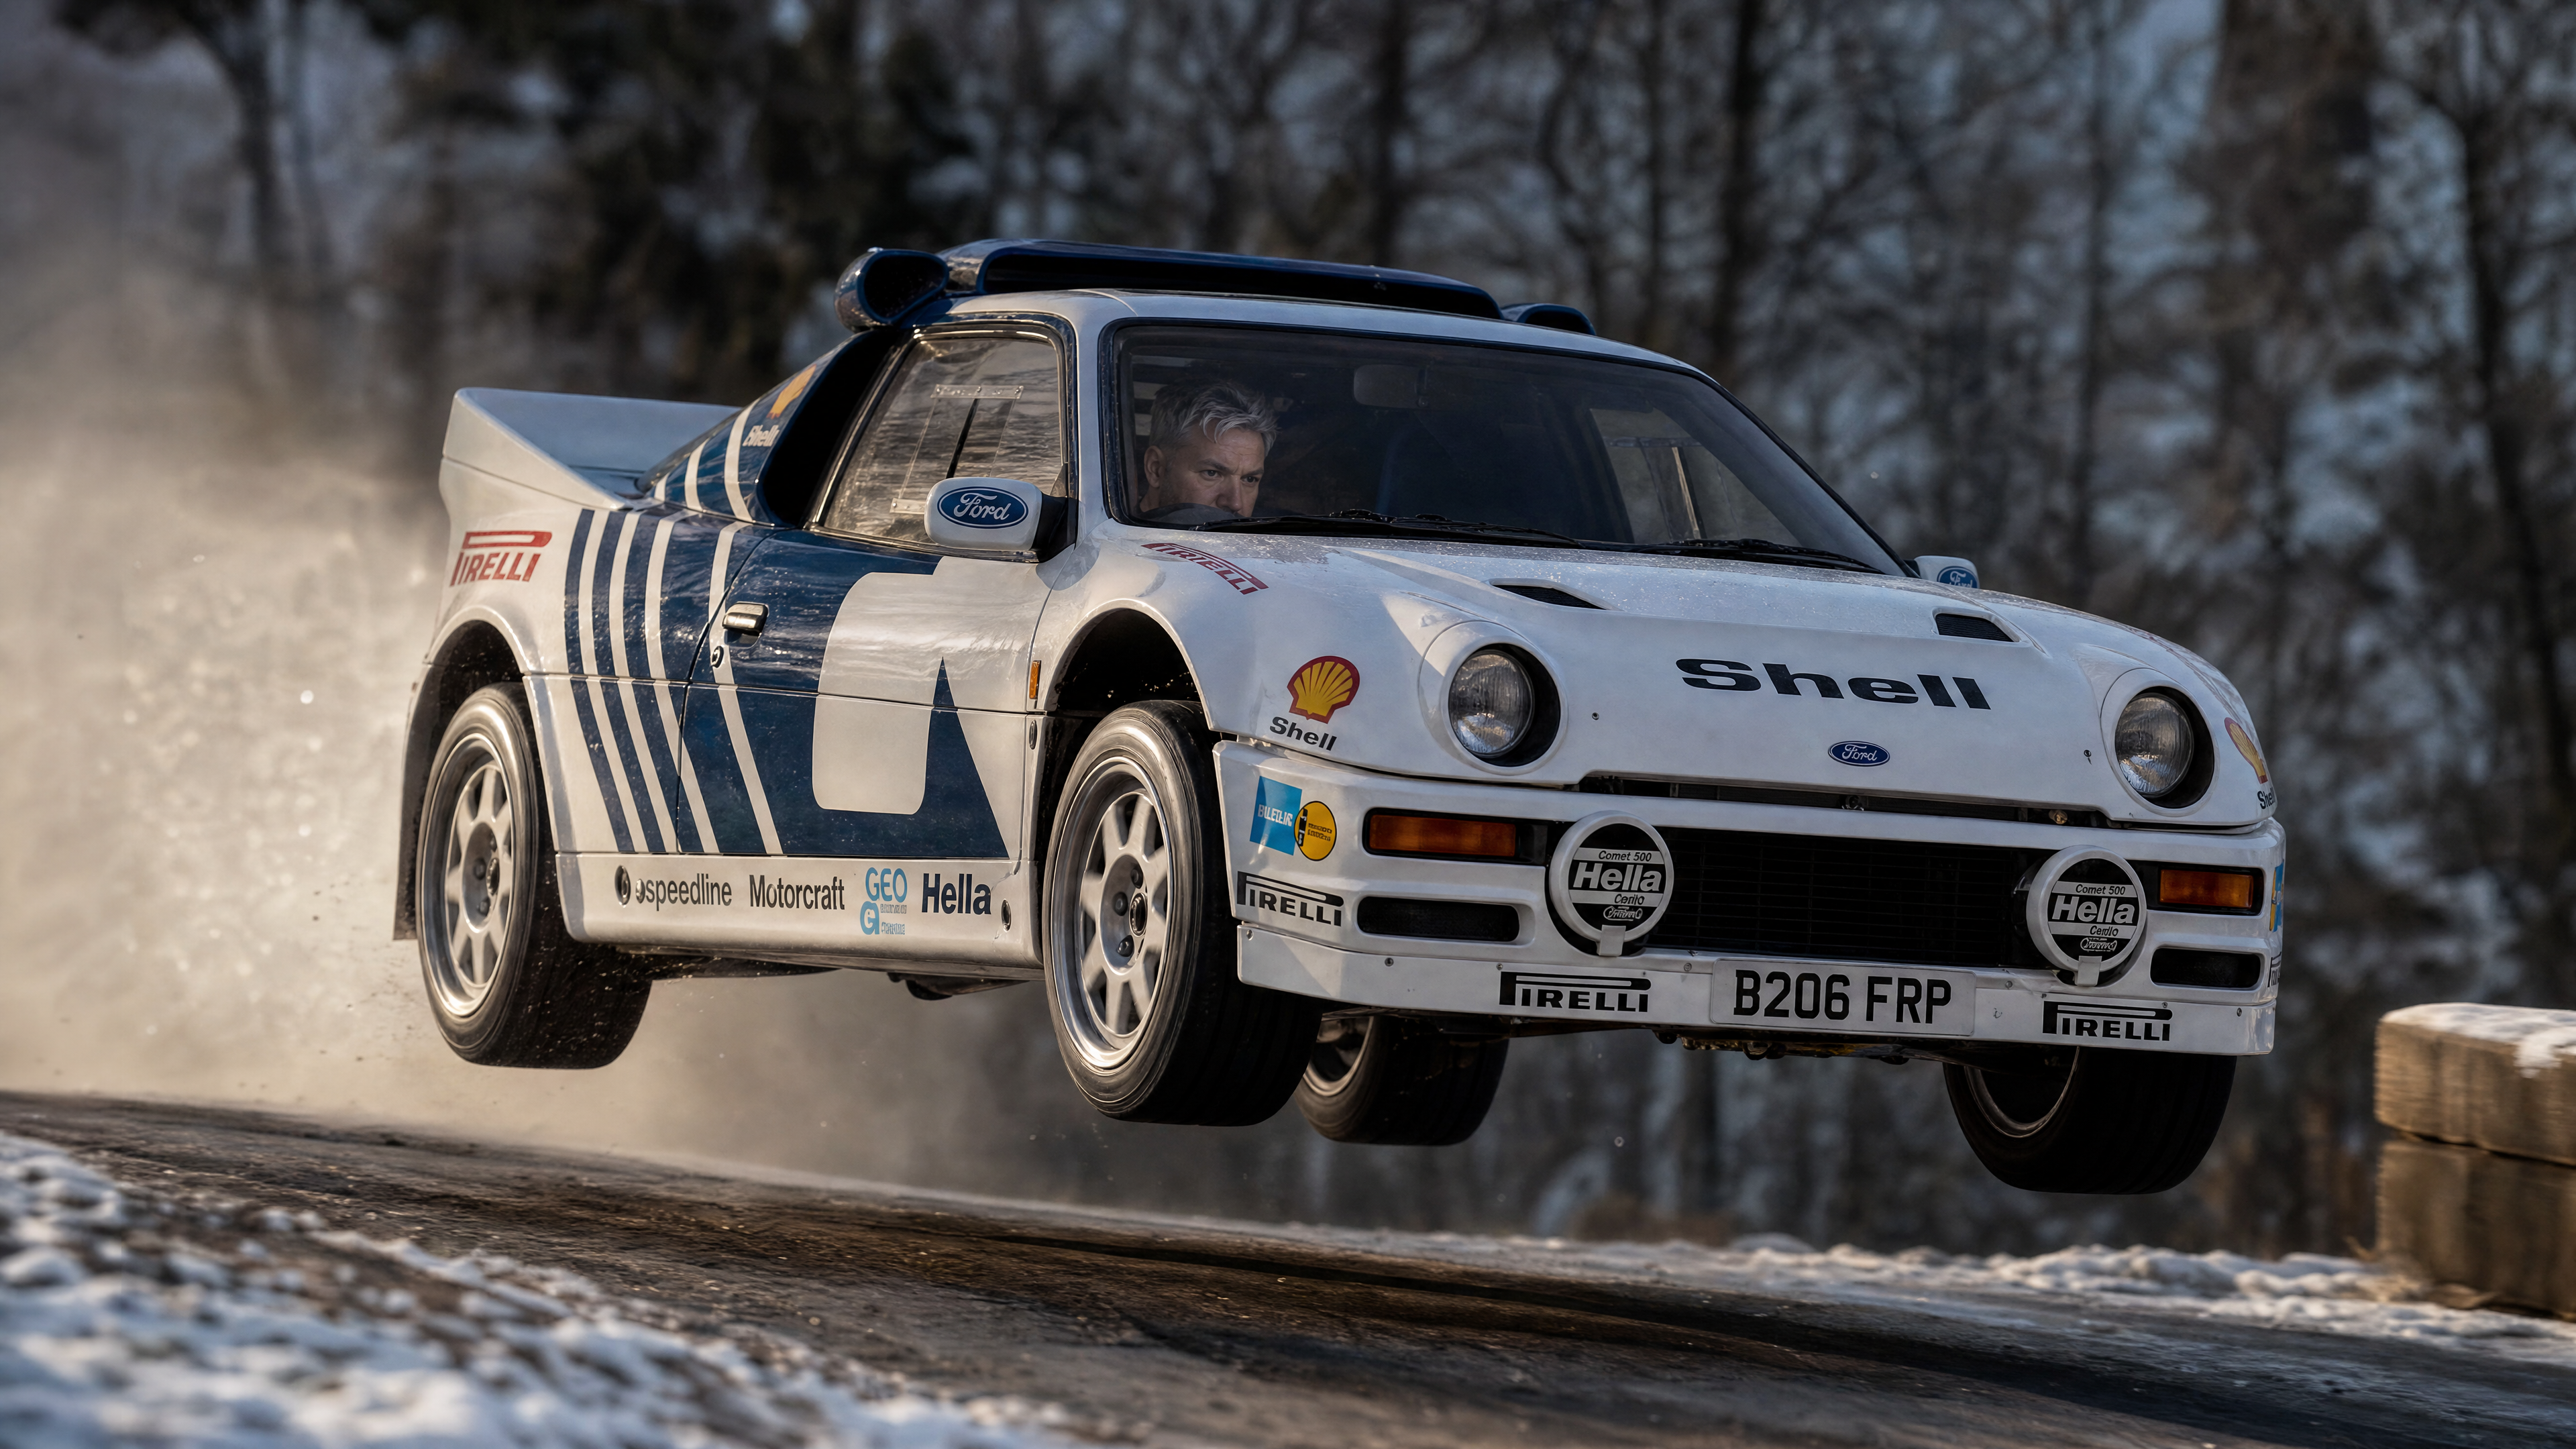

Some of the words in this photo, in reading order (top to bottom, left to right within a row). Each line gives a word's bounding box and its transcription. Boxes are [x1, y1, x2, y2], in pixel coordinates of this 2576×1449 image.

[953, 492, 1012, 521] Ford
[450, 531, 552, 587] PIRELLI
[1141, 543, 1269, 595] PIRELLI
[1676, 658, 1991, 710] Shell
[1269, 716, 1338, 751] Shell
[1841, 744, 1878, 762] Ford
[1599, 851, 1631, 861] Comet
[1633, 852, 1652, 862] 500
[749, 874, 845, 910] Motorcraft
[865, 867, 908, 903] GEO
[921, 873, 991, 915] Hella
[1572, 862, 1662, 892] Hella
[2076, 884, 2106, 894] Comet
[2108, 885, 2126, 896] 500
[1236, 871, 1344, 927] PIRELLI
[2051, 895, 2135, 924] Hella
[1499, 971, 1652, 1013] PIRELLI
[1733, 969, 1850, 1020] B206
[1866, 975, 1951, 1024] FRP
[2042, 1000, 2173, 1041] PIRELLI
